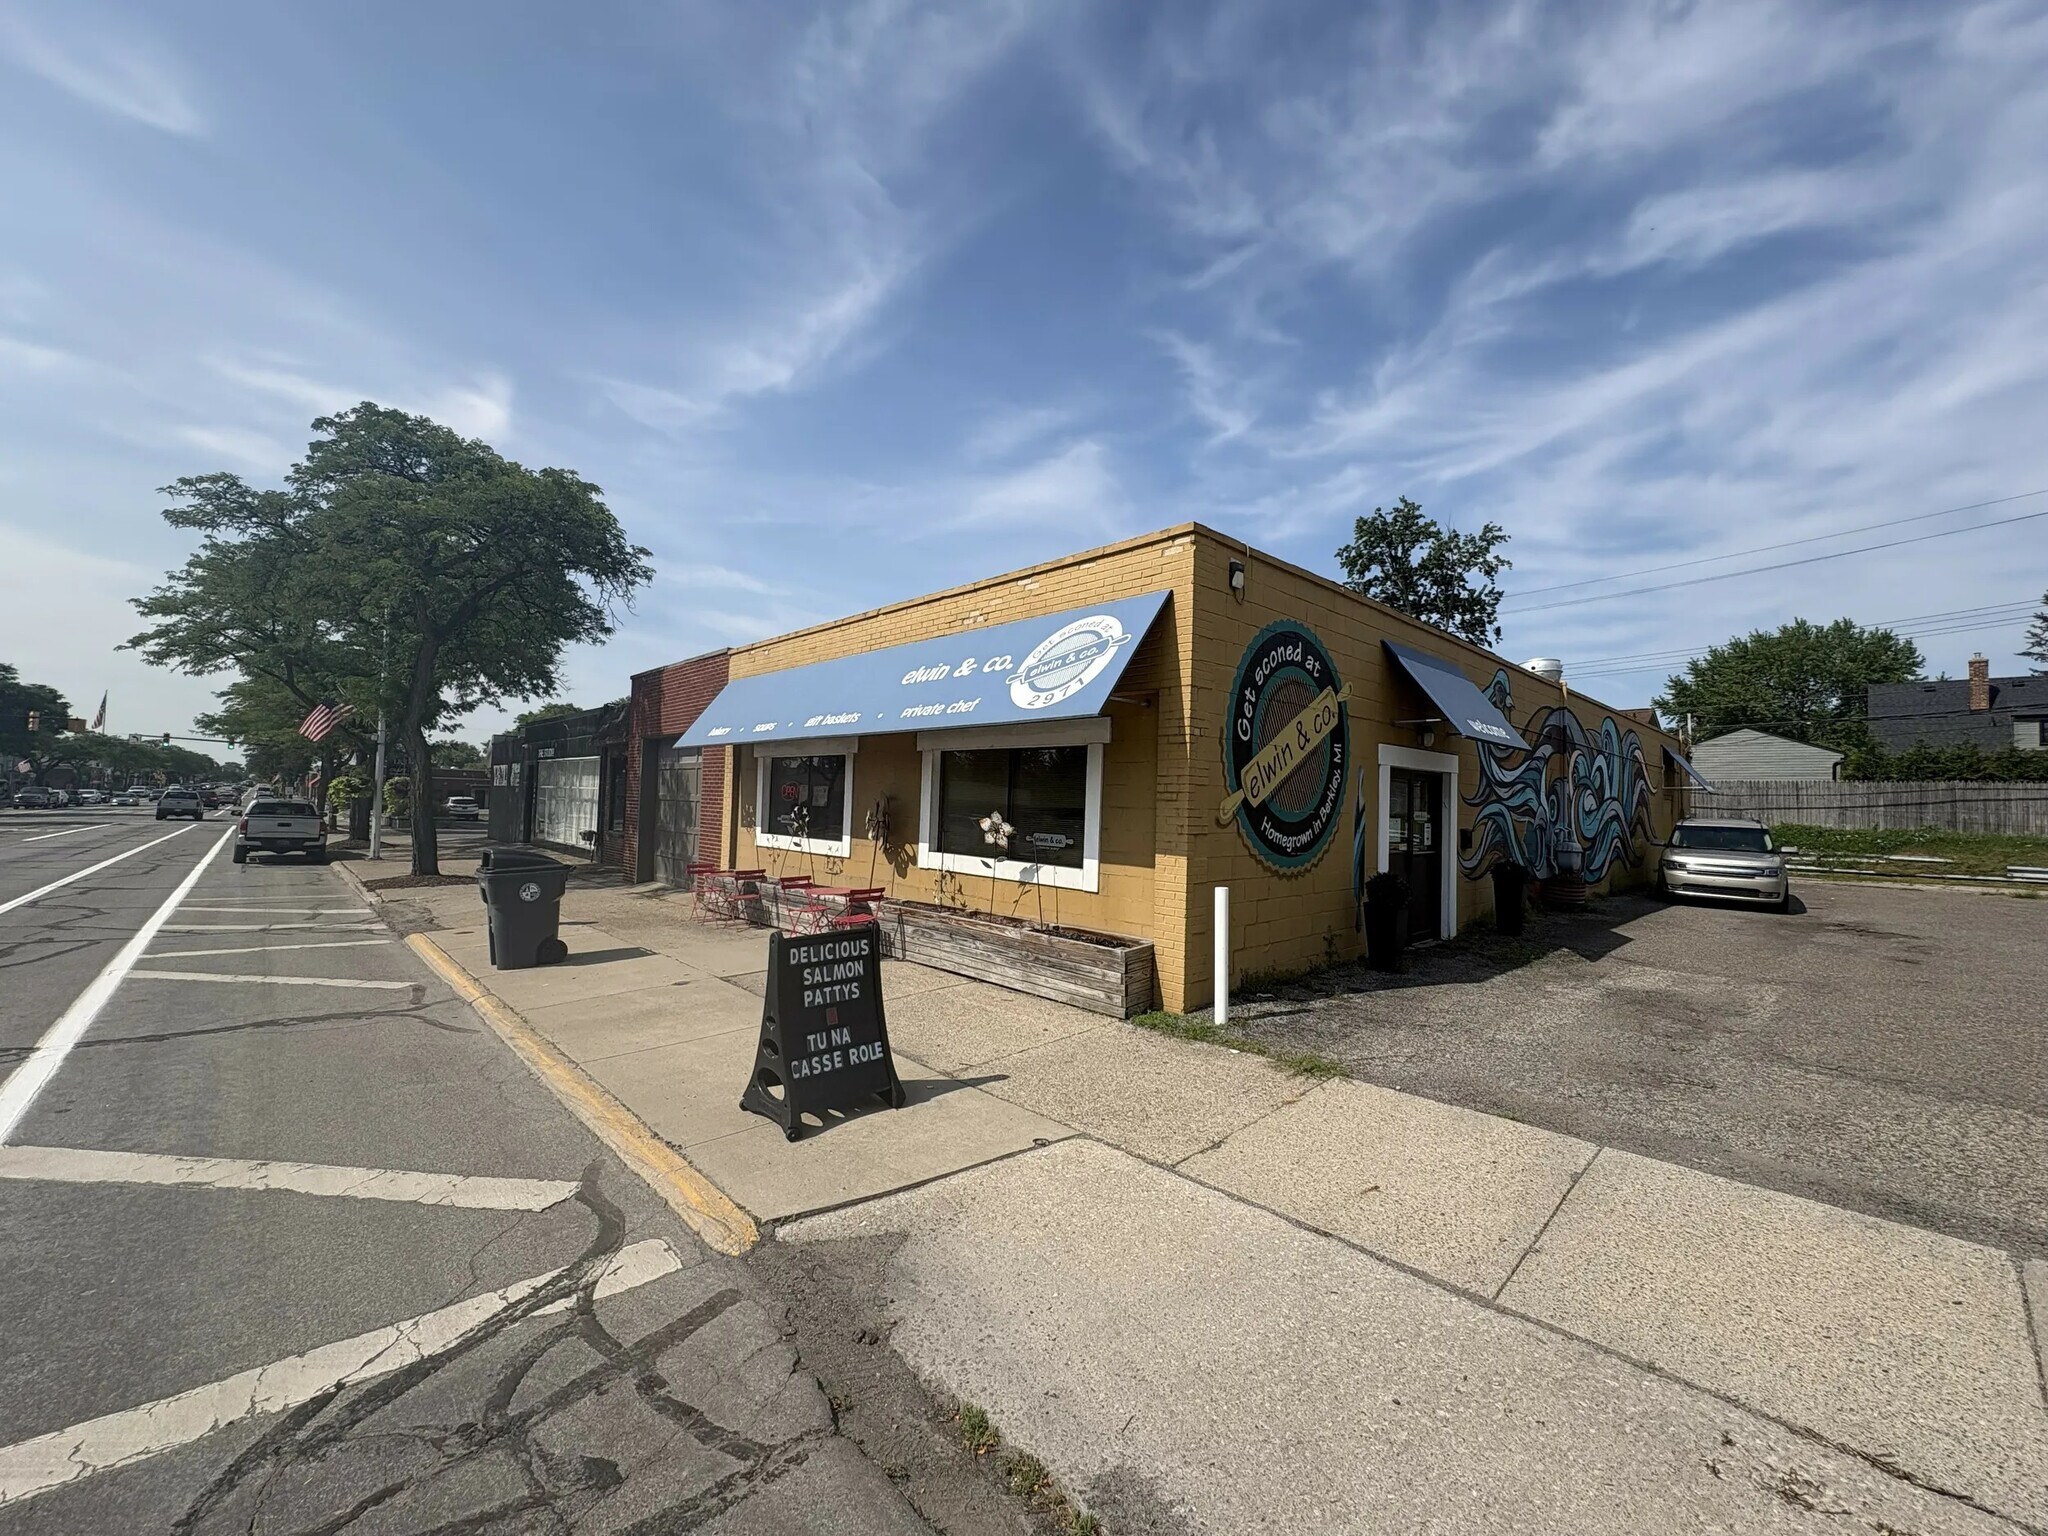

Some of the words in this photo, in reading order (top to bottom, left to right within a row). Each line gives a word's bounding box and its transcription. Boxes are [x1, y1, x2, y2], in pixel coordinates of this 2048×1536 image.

[1032, 639, 1055, 659] Get
[1059, 619, 1104, 638] sconed
[901, 663, 950, 685] elwin
[953, 657, 977, 678] &
[982, 655, 1014, 673] co.
[1029, 659, 1062, 677] elwin
[1065, 653, 1076, 664] &
[1079, 646, 1099, 659] co.
[1027, 678, 1084, 707] 2971
[1237, 687, 1255, 741] Get
[1255, 641, 1302, 686] sconed
[1305, 655, 1321, 677] at
[900, 703, 945, 719] private
[946, 698, 981, 714] chef
[1249, 743, 1294, 799] elwin
[1296, 720, 1310, 751] &
[1314, 705, 1336, 734] co.
[1261, 816, 1313, 852] Homegrown
[1312, 820, 1322, 835] in
[1333, 743, 1342, 763] MI
[789, 939, 870, 965] DELICIOUS
[803, 960, 864, 985] SALMON
[804, 982, 860, 1007] PATTYS
